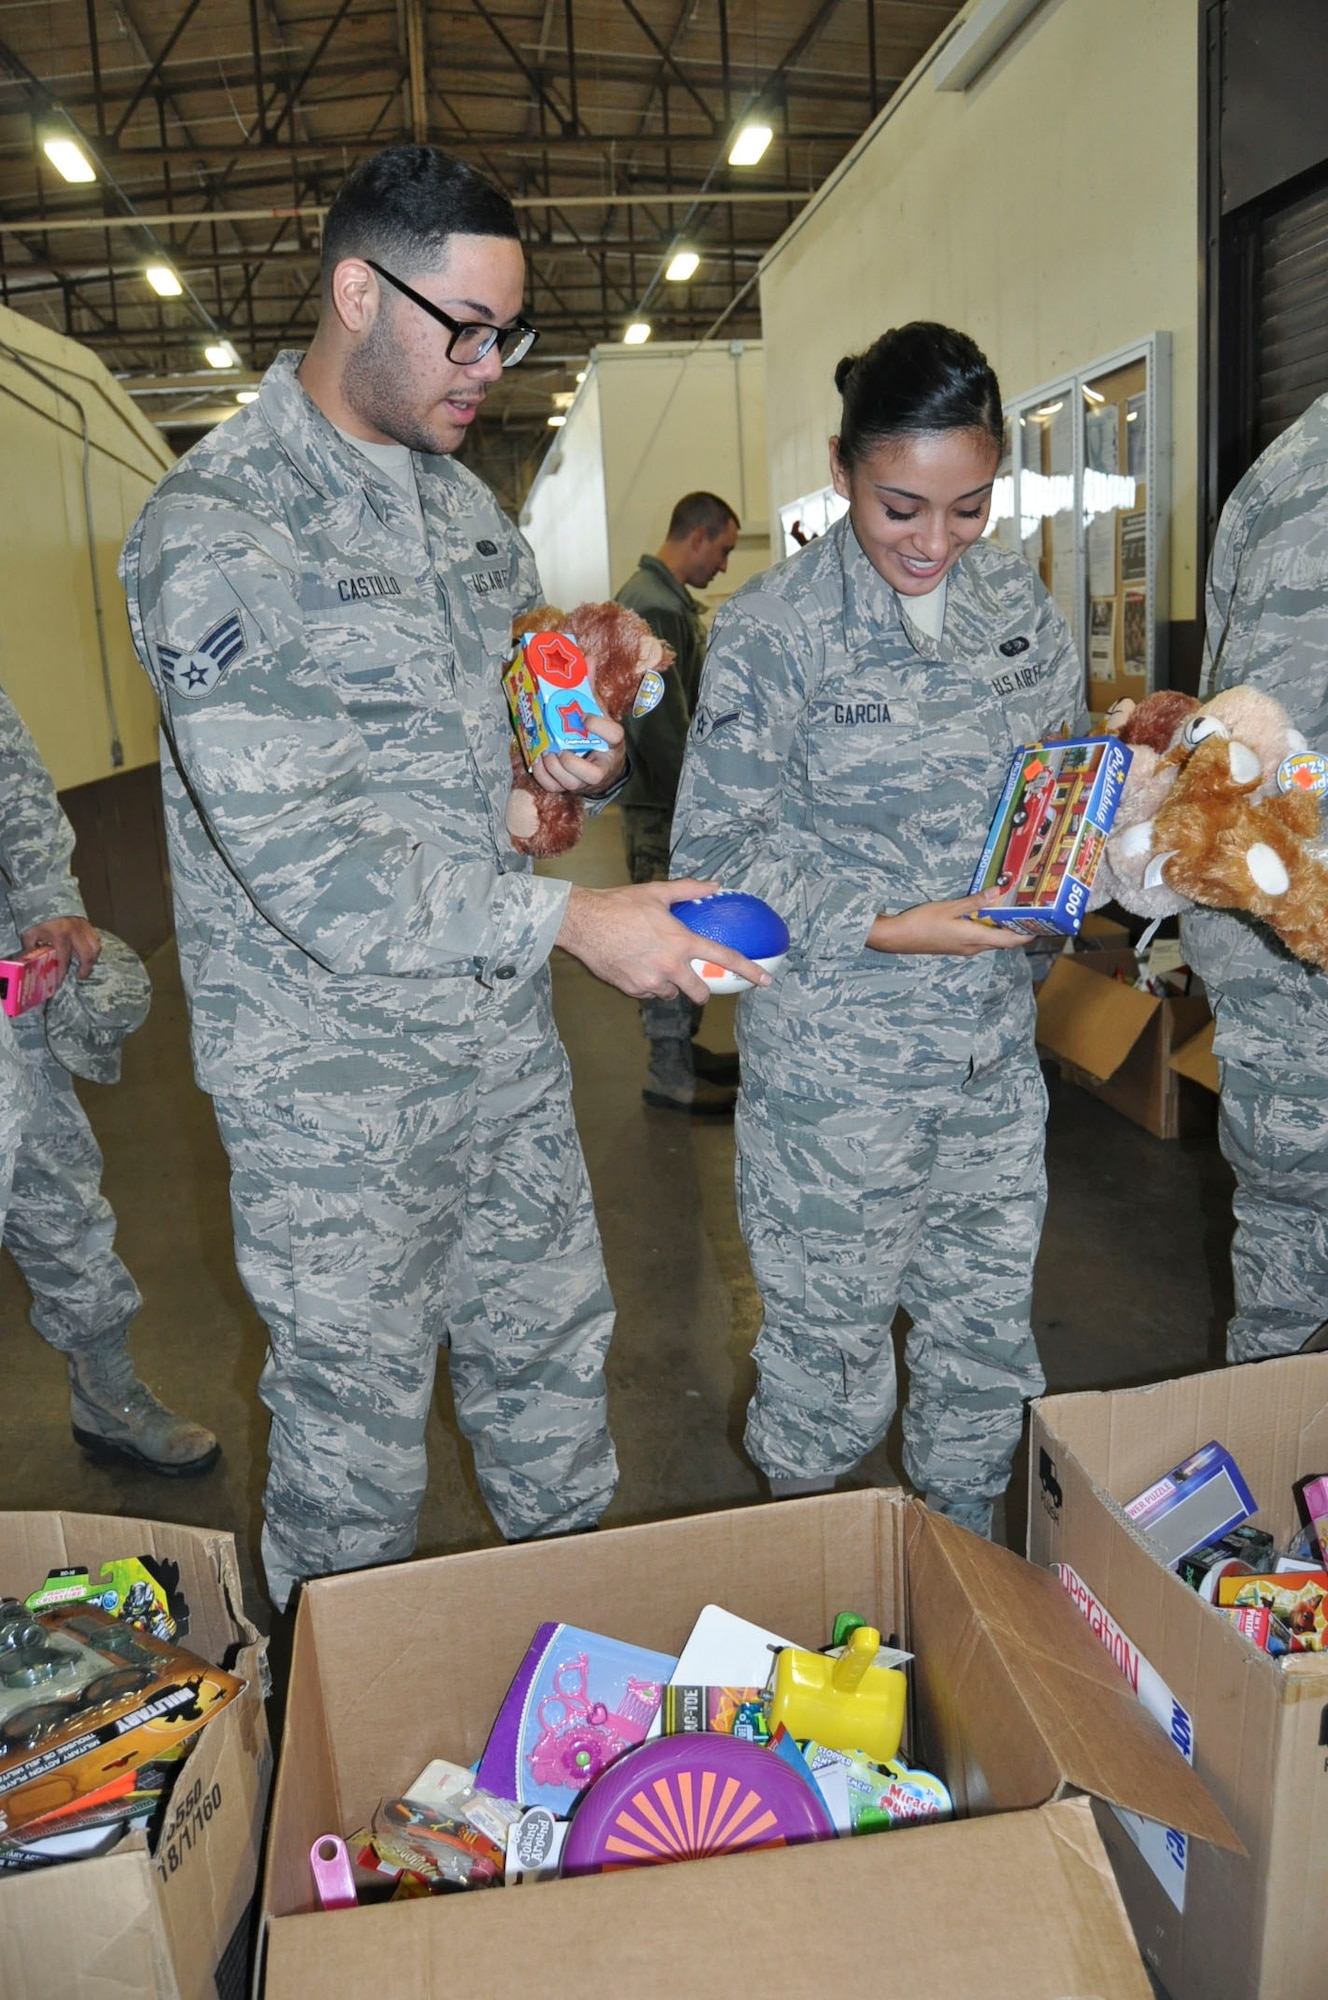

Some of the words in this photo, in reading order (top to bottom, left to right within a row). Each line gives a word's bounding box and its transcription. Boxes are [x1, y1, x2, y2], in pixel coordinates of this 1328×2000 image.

[338, 575, 401, 602] CASTILLO
[834, 703, 892, 724] GARCIA
[1065, 883, 1084, 916] 500
[1144, 1482, 1173, 1504] PUZZLE
[115, 1687, 196, 1734] MILITARY
[57, 1732, 96, 1755] TROUSSE
[63, 1739, 101, 1761] MILITARY
[25, 1757, 43, 1770] JEU
[43, 1752, 57, 1761] DE
[818, 1745, 853, 1767] STOPPER
[29, 1759, 61, 1777] ACTION
[889, 1783, 940, 1815] Miracle
[157, 1782, 222, 1883] 18/1/160
[519, 1823, 539, 1863] Joking
[532, 1818, 550, 1863] Around
